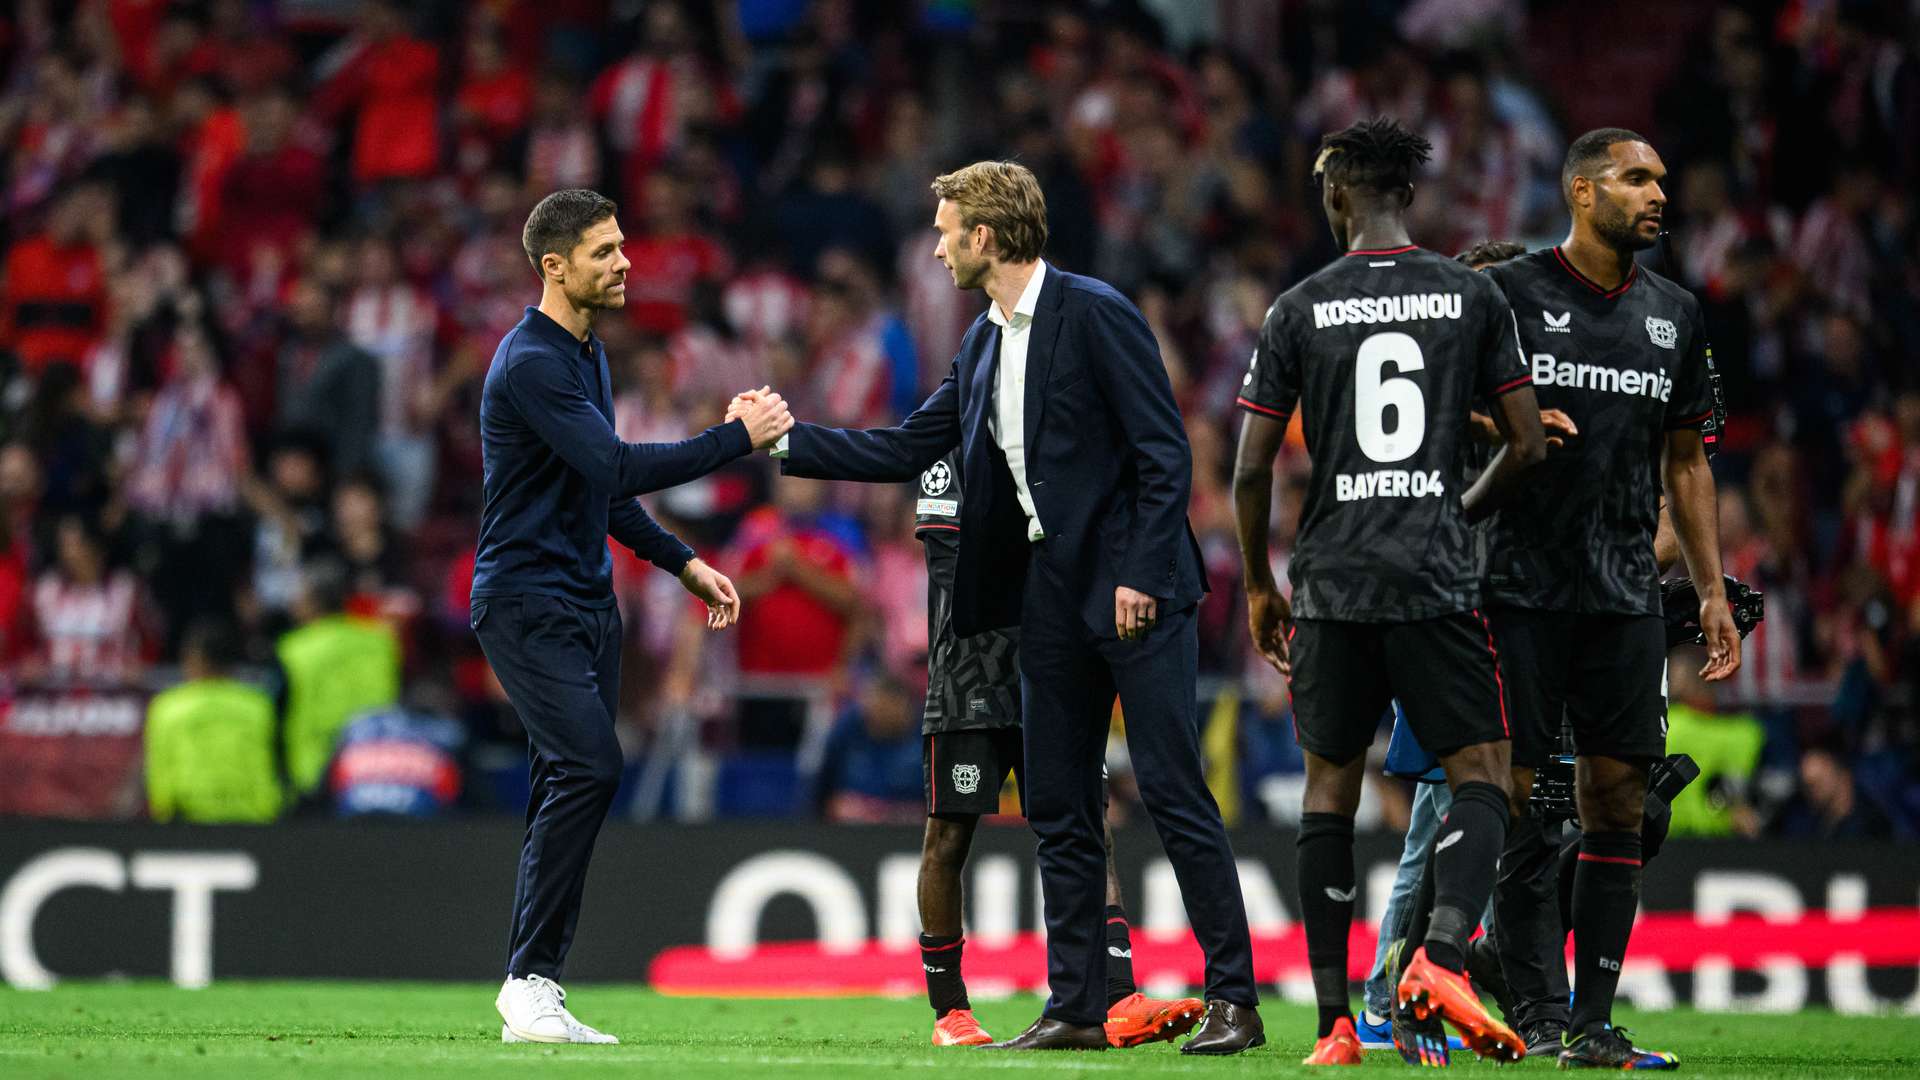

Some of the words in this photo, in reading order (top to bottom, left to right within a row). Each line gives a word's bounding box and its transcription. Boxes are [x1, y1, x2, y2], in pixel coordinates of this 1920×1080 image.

[1312, 293, 1462, 329] KOSSOUNOU
[1355, 331, 1425, 463] 6
[1531, 353, 1673, 403] Barmenia
